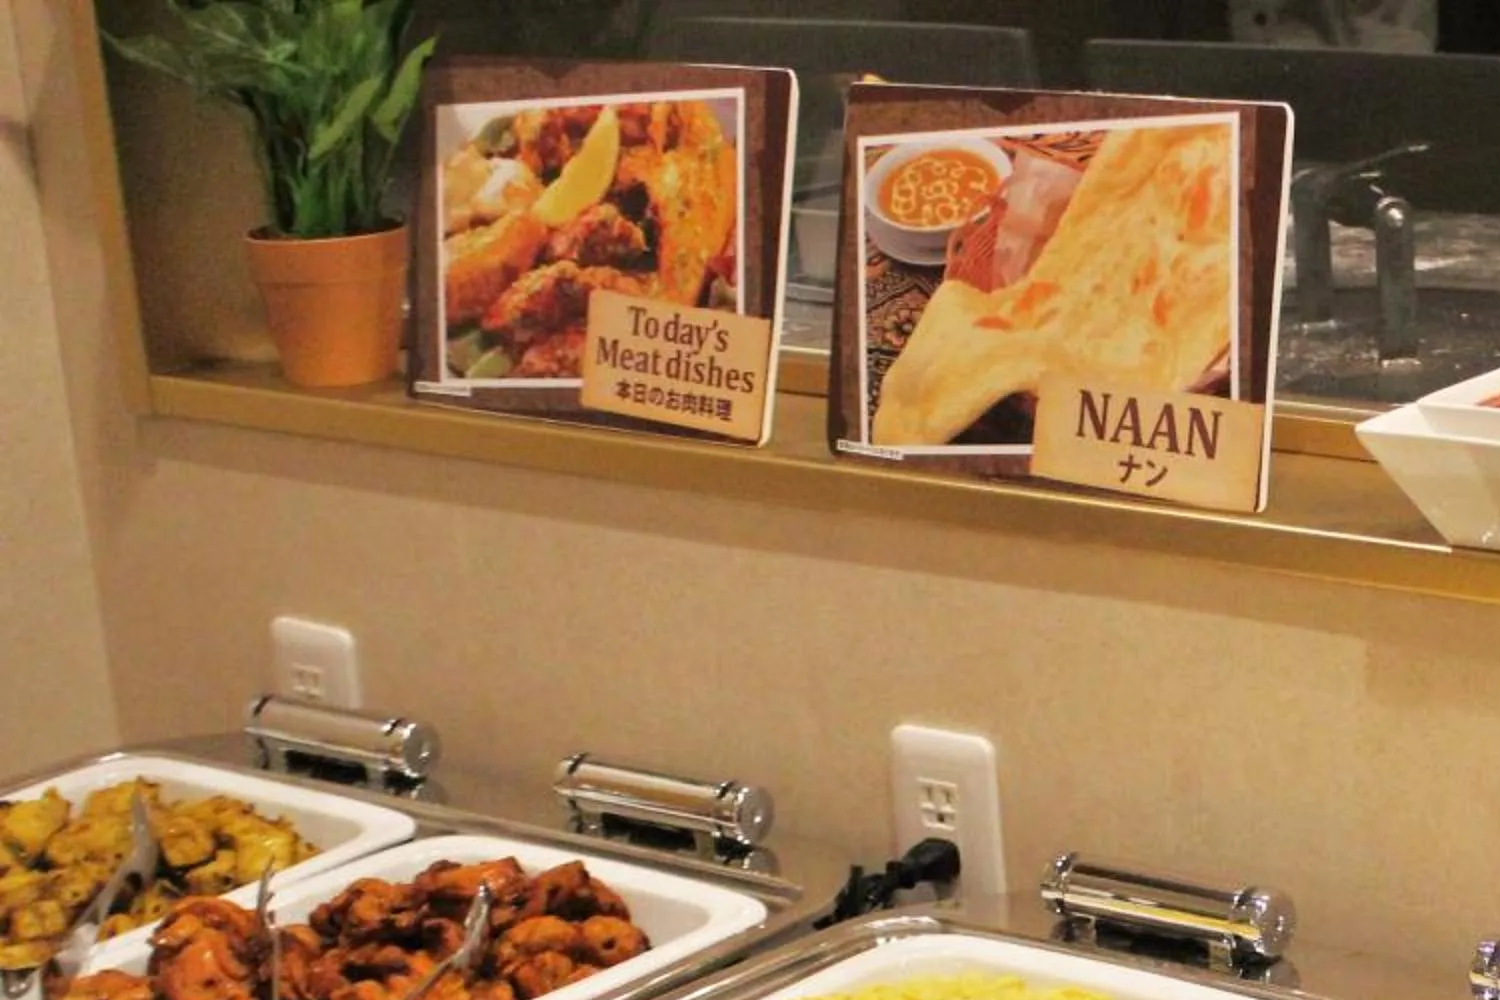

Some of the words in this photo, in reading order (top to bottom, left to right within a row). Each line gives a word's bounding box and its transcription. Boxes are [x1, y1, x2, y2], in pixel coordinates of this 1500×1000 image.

[627, 304, 730, 355] Today's
[596, 335, 662, 377] Meat
[664, 349, 756, 394] dishes
[615, 378, 733, 422] 本日のお肉料理
[1075, 388, 1224, 460] NAAN
[1117, 453, 1169, 487] ナン
